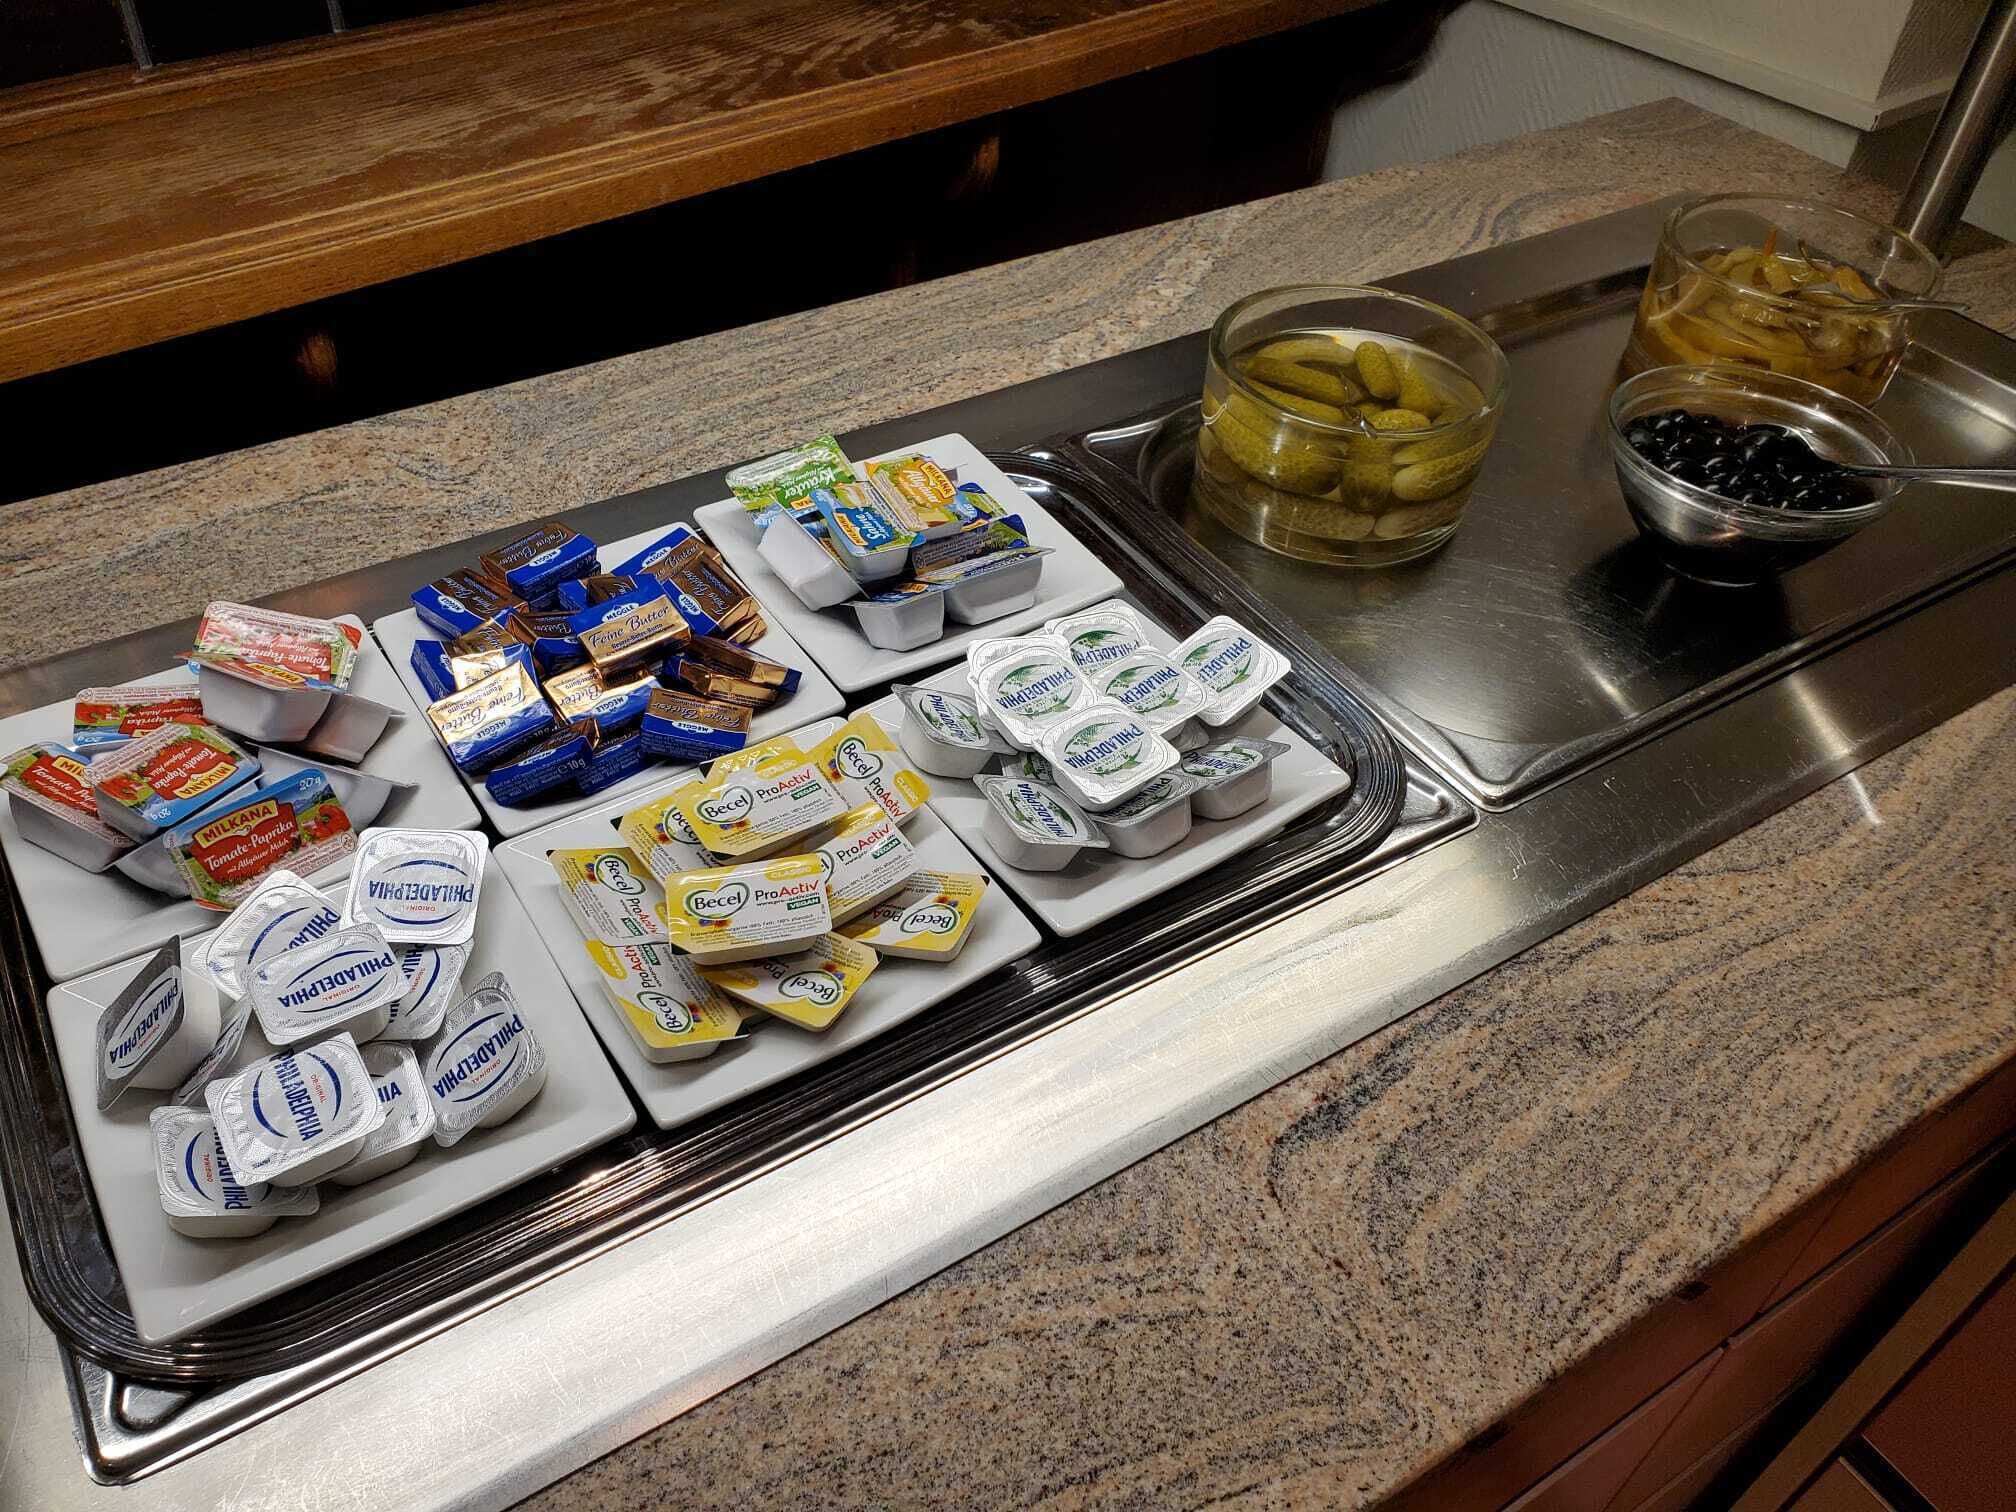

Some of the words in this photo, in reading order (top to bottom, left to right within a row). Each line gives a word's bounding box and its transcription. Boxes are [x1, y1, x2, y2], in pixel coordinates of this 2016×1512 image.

[785, 467, 836, 499] Kräuter
[927, 465, 952, 494] MILKANA
[856, 514, 886, 540] Sahne
[588, 629, 625, 648] Feine
[626, 605, 670, 632] Butter
[606, 605, 634, 621] MEGGLE
[253, 663, 299, 683] MILKANA
[1197, 636, 1253, 683] PHILADEL
[487, 687, 527, 711] Feine
[559, 684, 602, 707] Butter
[995, 665, 1076, 710] PHILADELPHIA
[1119, 665, 1181, 706] PHILADELPH
[440, 706, 487, 733] Butter
[596, 696, 626, 712] MEGGLE
[478, 719, 508, 739] MEGGLE
[842, 742, 874, 776] Becel
[1064, 722, 1145, 770] PHILADELPHIA
[153, 746, 218, 790] Tomate-Paprika
[178, 765, 232, 795] MILKANA
[755, 769, 812, 800] ProActiv
[794, 783, 821, 799] VEGAN
[868, 776, 906, 818] ProActiv
[704, 794, 750, 819] Becel
[1017, 783, 1074, 839] PHILADELPHIA
[203, 804, 273, 842] MILKANA
[204, 820, 294, 872] Tomate-Paprika
[836, 823, 891, 862] ProActiv
[368, 880, 475, 903] PHILADELPHIA
[604, 860, 635, 892] Becel
[754, 879, 819, 901] ProActiv
[694, 891, 743, 911] Becel
[788, 897, 820, 910] VEGAN
[909, 914, 953, 929] Becel
[277, 951, 397, 1009] PHILADELPHIA
[324, 983, 361, 1002] ORIGINAL
[790, 975, 836, 1001] Becel
[109, 977, 179, 1065] PHILADELPHIA
[648, 996, 684, 1030] Becel
[432, 1013, 525, 1099] PHILADELPHIA
[471, 1059, 502, 1084] ORIGINAL
[268, 1048, 324, 1142] PHILADELPHIA
[310, 1073, 328, 1104] ORIGINAL
[205, 1152, 213, 1184] ORIGINAL
